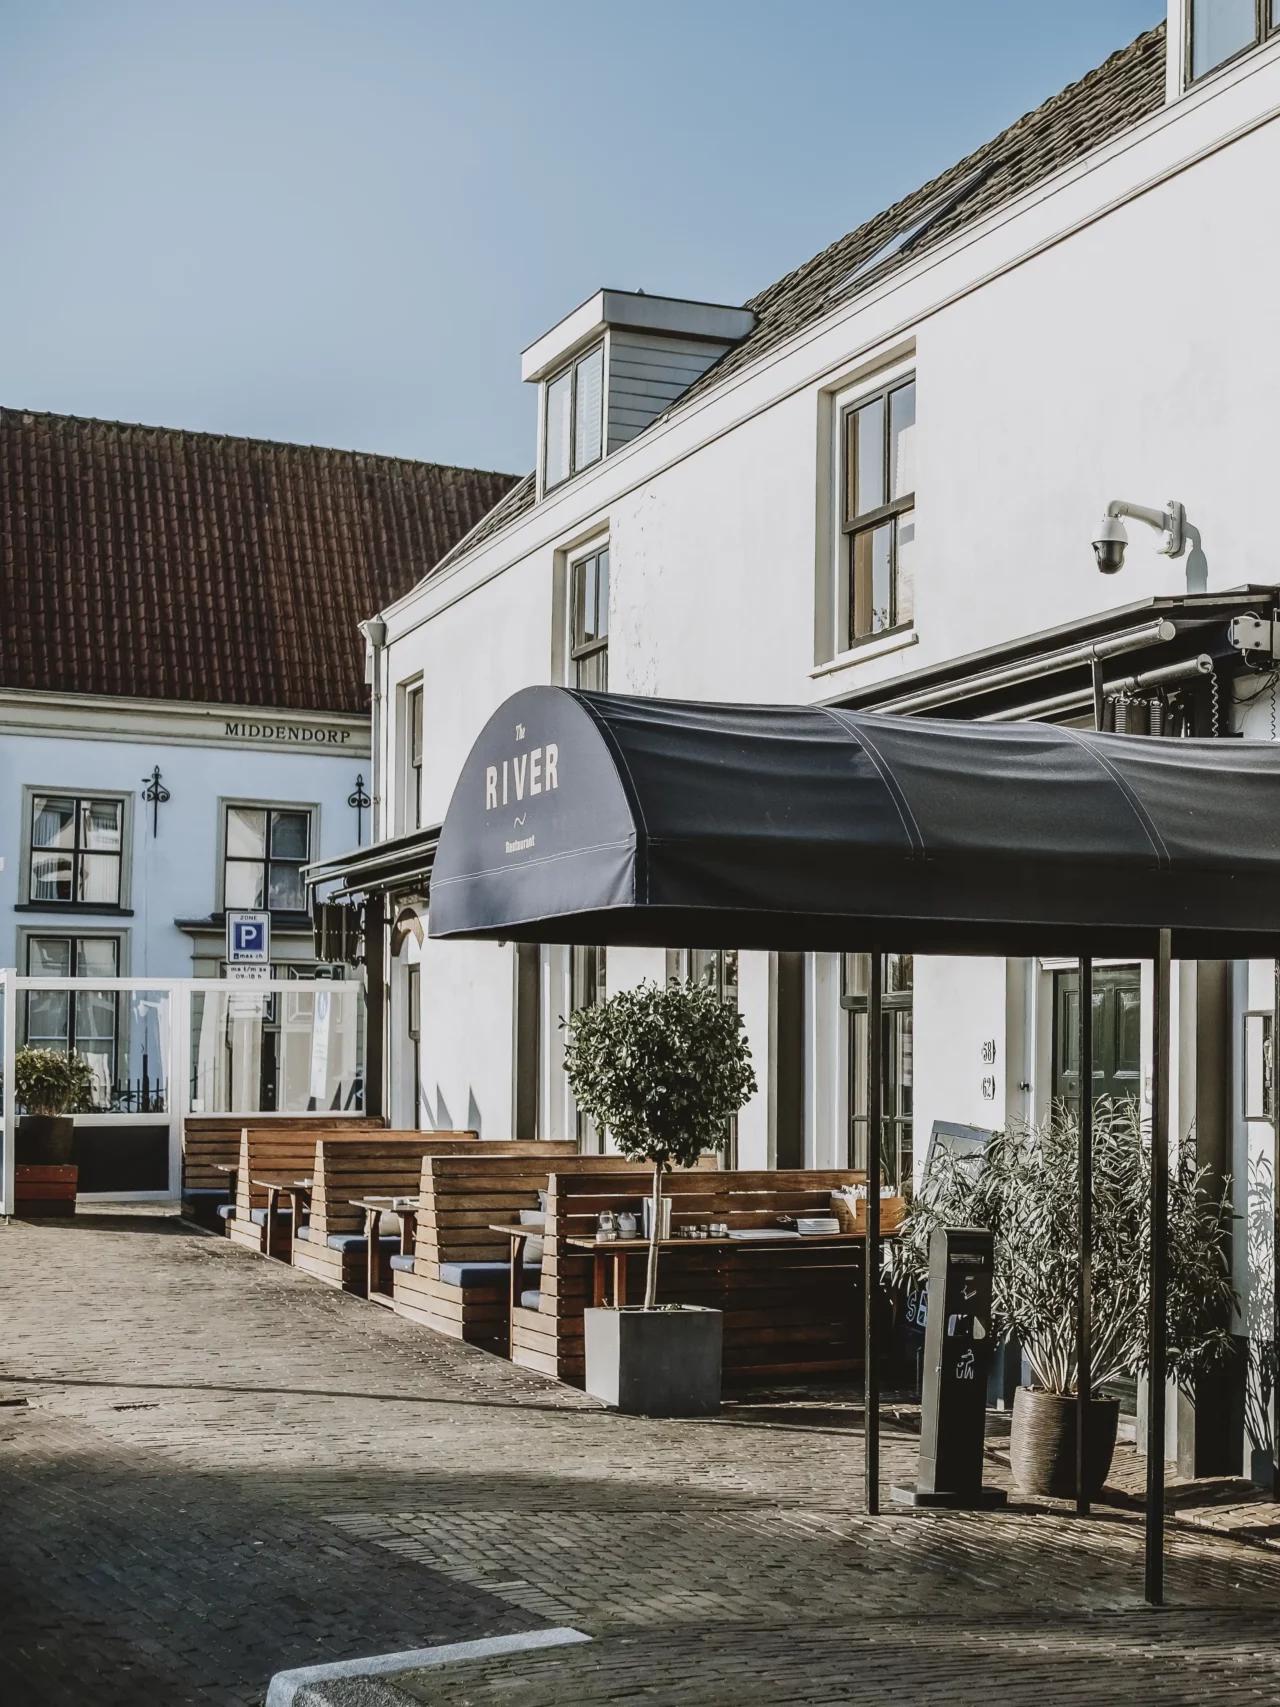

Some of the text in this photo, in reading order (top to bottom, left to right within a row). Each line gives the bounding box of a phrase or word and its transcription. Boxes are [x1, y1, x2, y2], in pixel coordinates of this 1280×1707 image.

[225, 723, 351, 743] MIDDENDORP
[515, 723, 526, 741] The
[486, 743, 559, 811] RIVER
[505, 834, 535, 854] Restaurant
[241, 925, 257, 948] P
[983, 1041, 992, 1061] 58
[983, 1077, 992, 1098] 62
